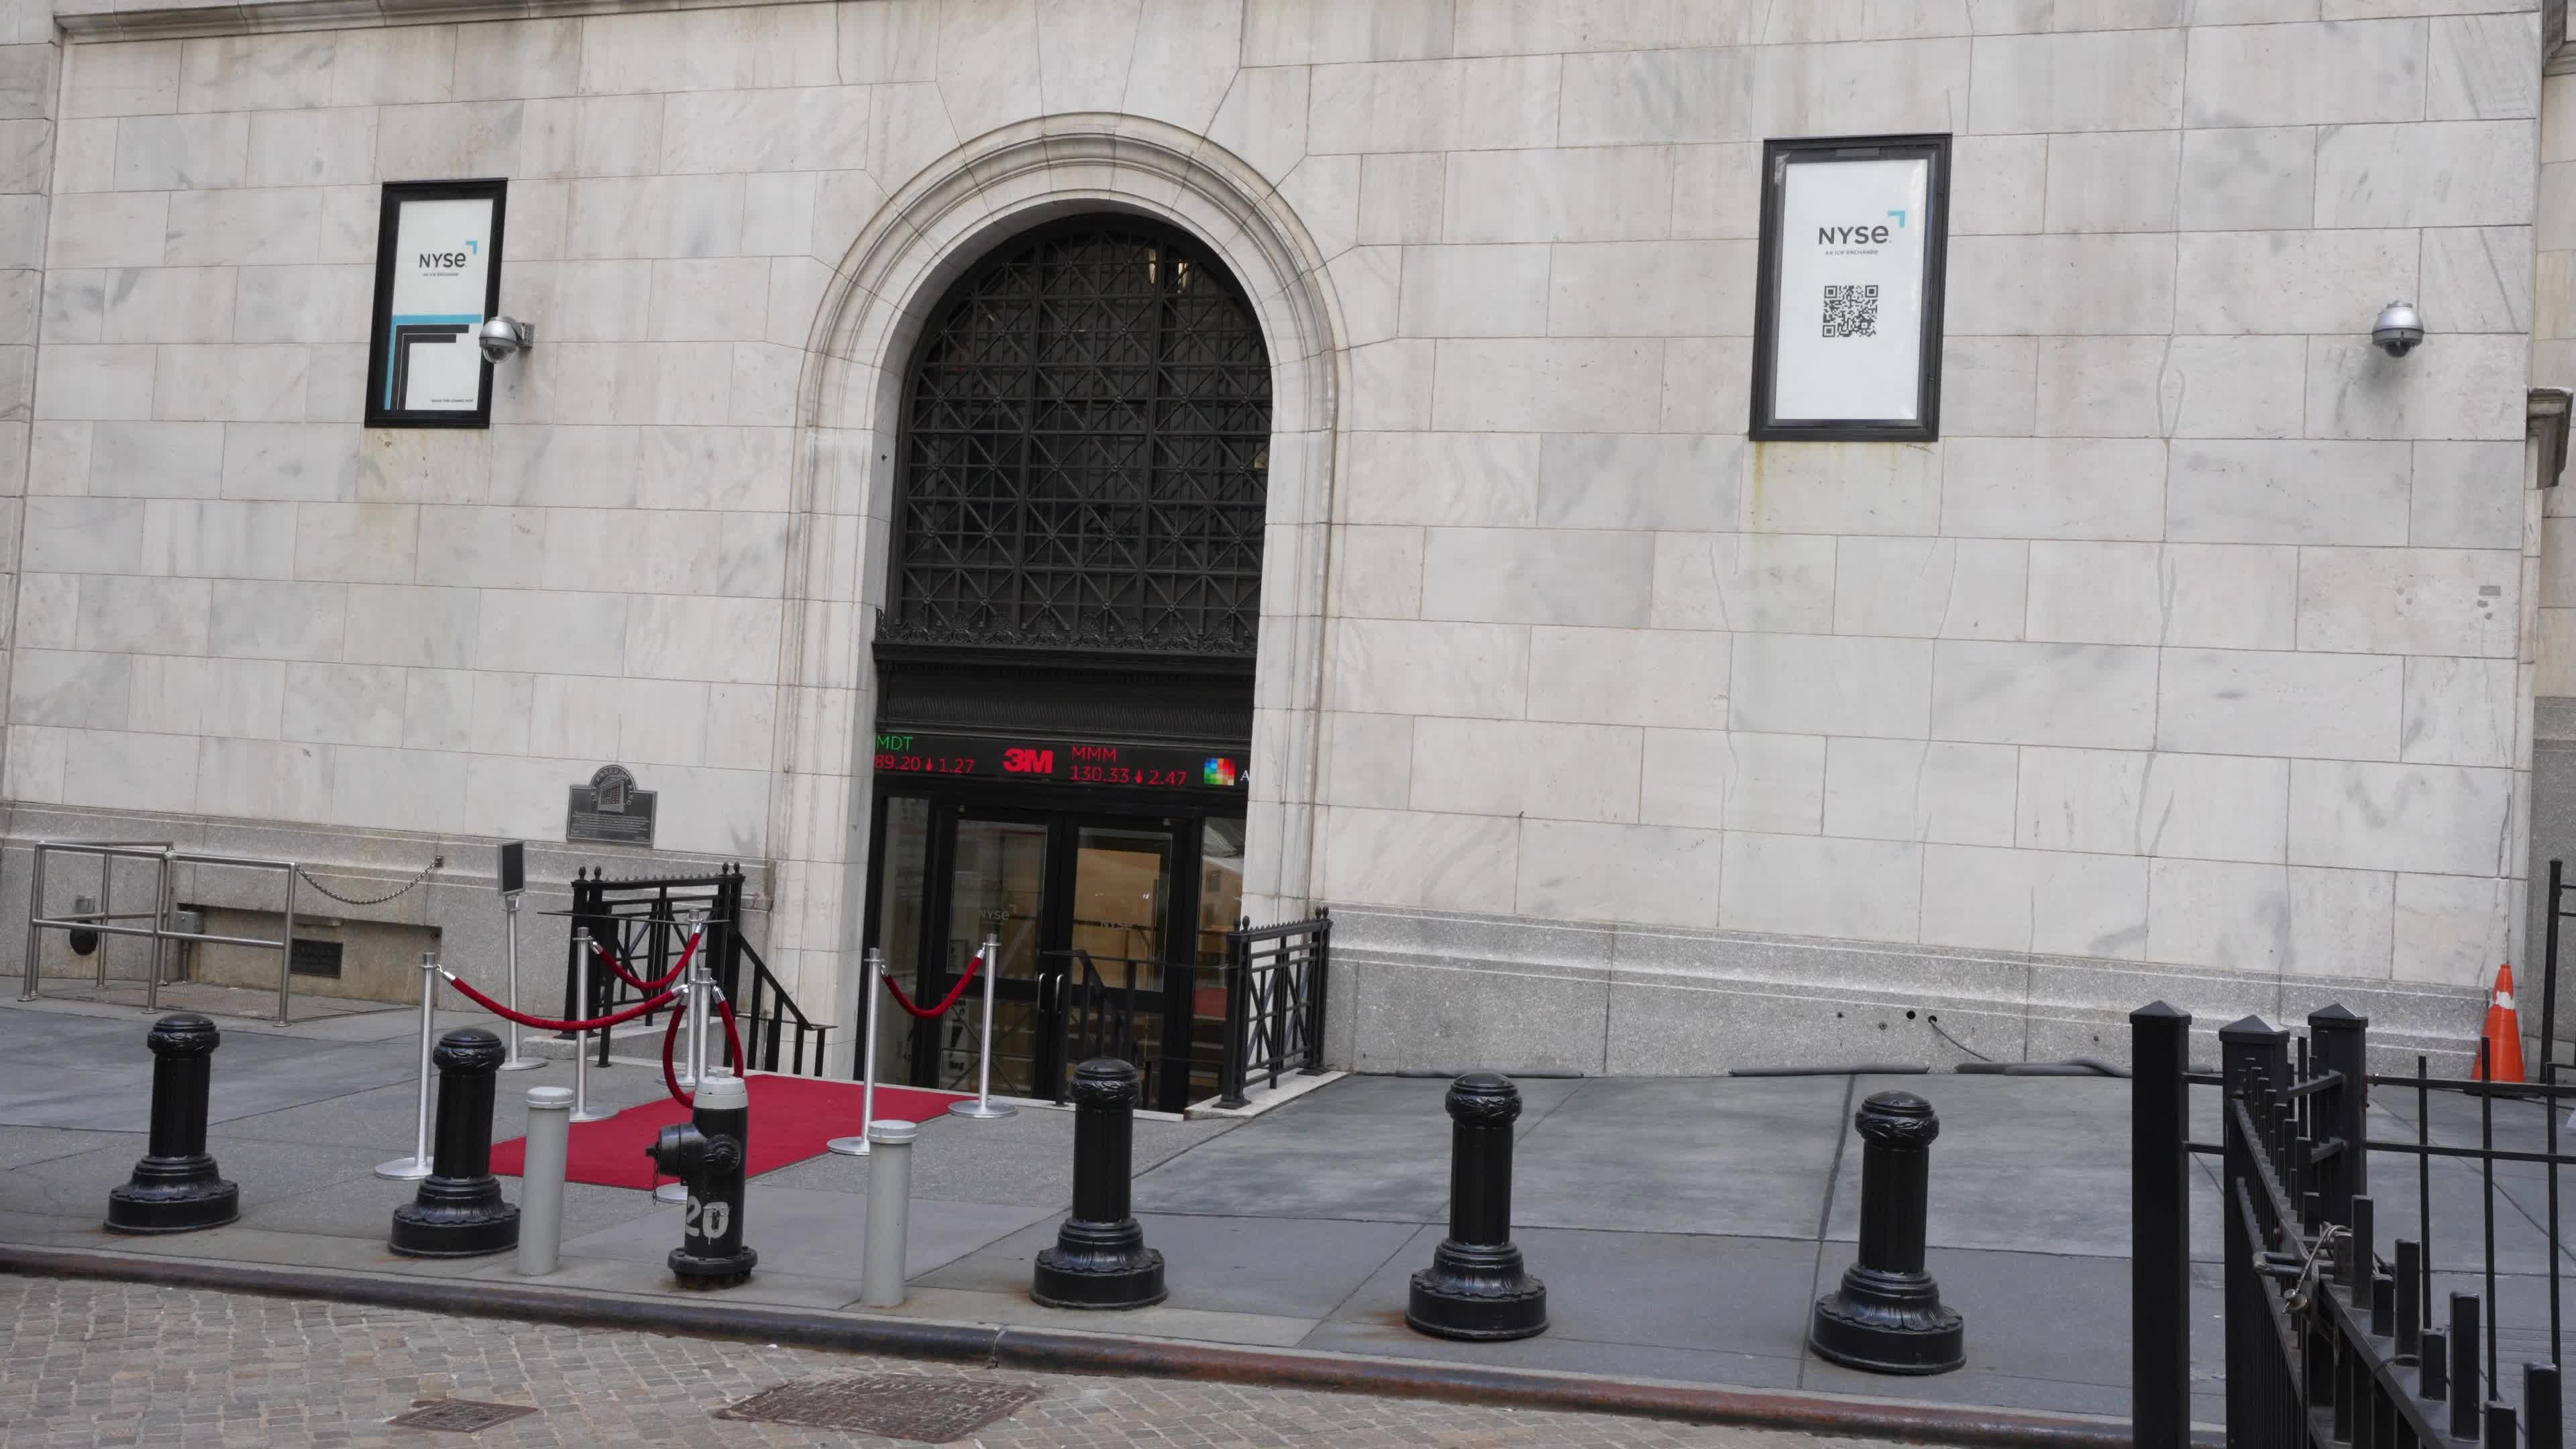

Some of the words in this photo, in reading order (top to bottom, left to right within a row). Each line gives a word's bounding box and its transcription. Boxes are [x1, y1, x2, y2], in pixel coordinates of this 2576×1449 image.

[876, 735, 913, 751] MDT
[875, 754, 921, 771] 89.20
[939, 758, 975, 773] 1.27
[1003, 748, 1054, 773] 3M
[1071, 745, 1117, 763] MMM
[1070, 765, 1130, 784] 130.33
[1148, 769, 1187, 786] 2.47
[685, 1195, 730, 1240] 20
